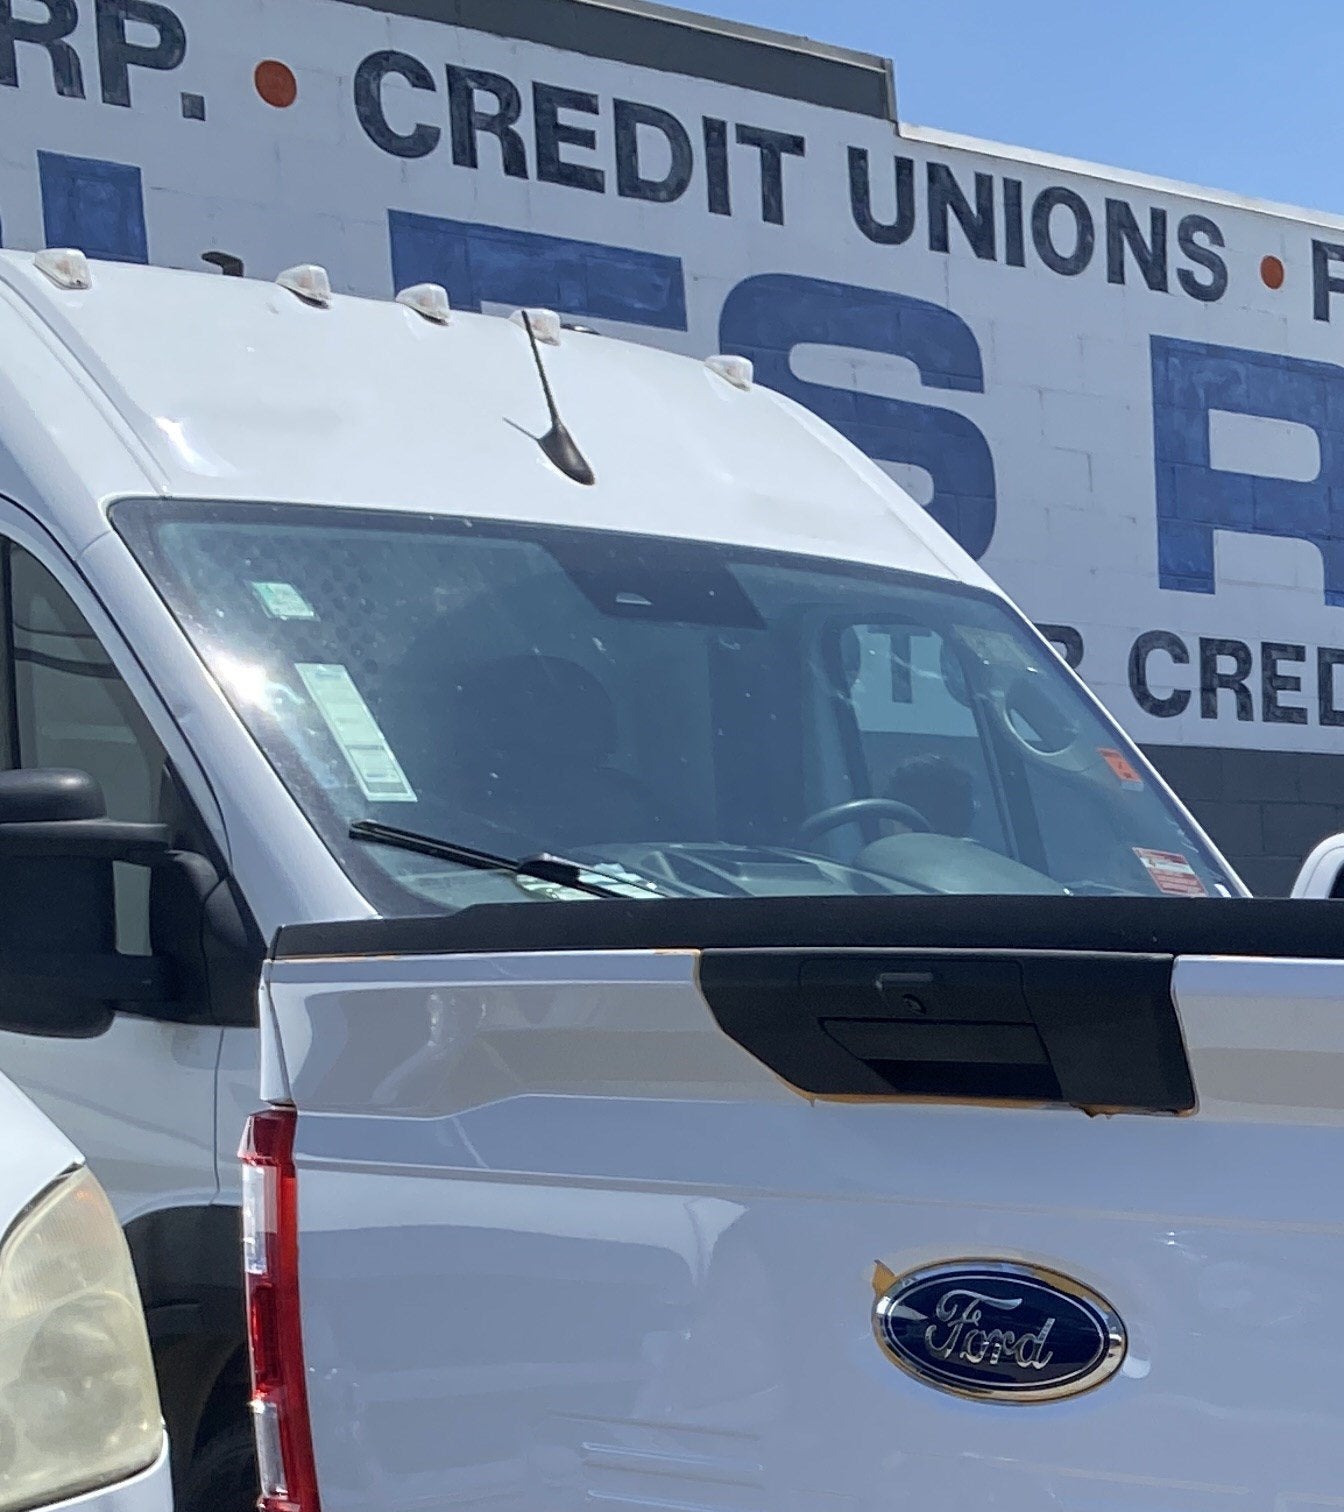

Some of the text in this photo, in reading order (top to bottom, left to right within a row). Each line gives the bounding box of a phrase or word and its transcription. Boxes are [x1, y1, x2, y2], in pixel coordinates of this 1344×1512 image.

[353, 49, 804, 226] CREDIT
[847, 146, 1229, 303] UNIONS
[924, 1289, 1056, 1370] Ford
